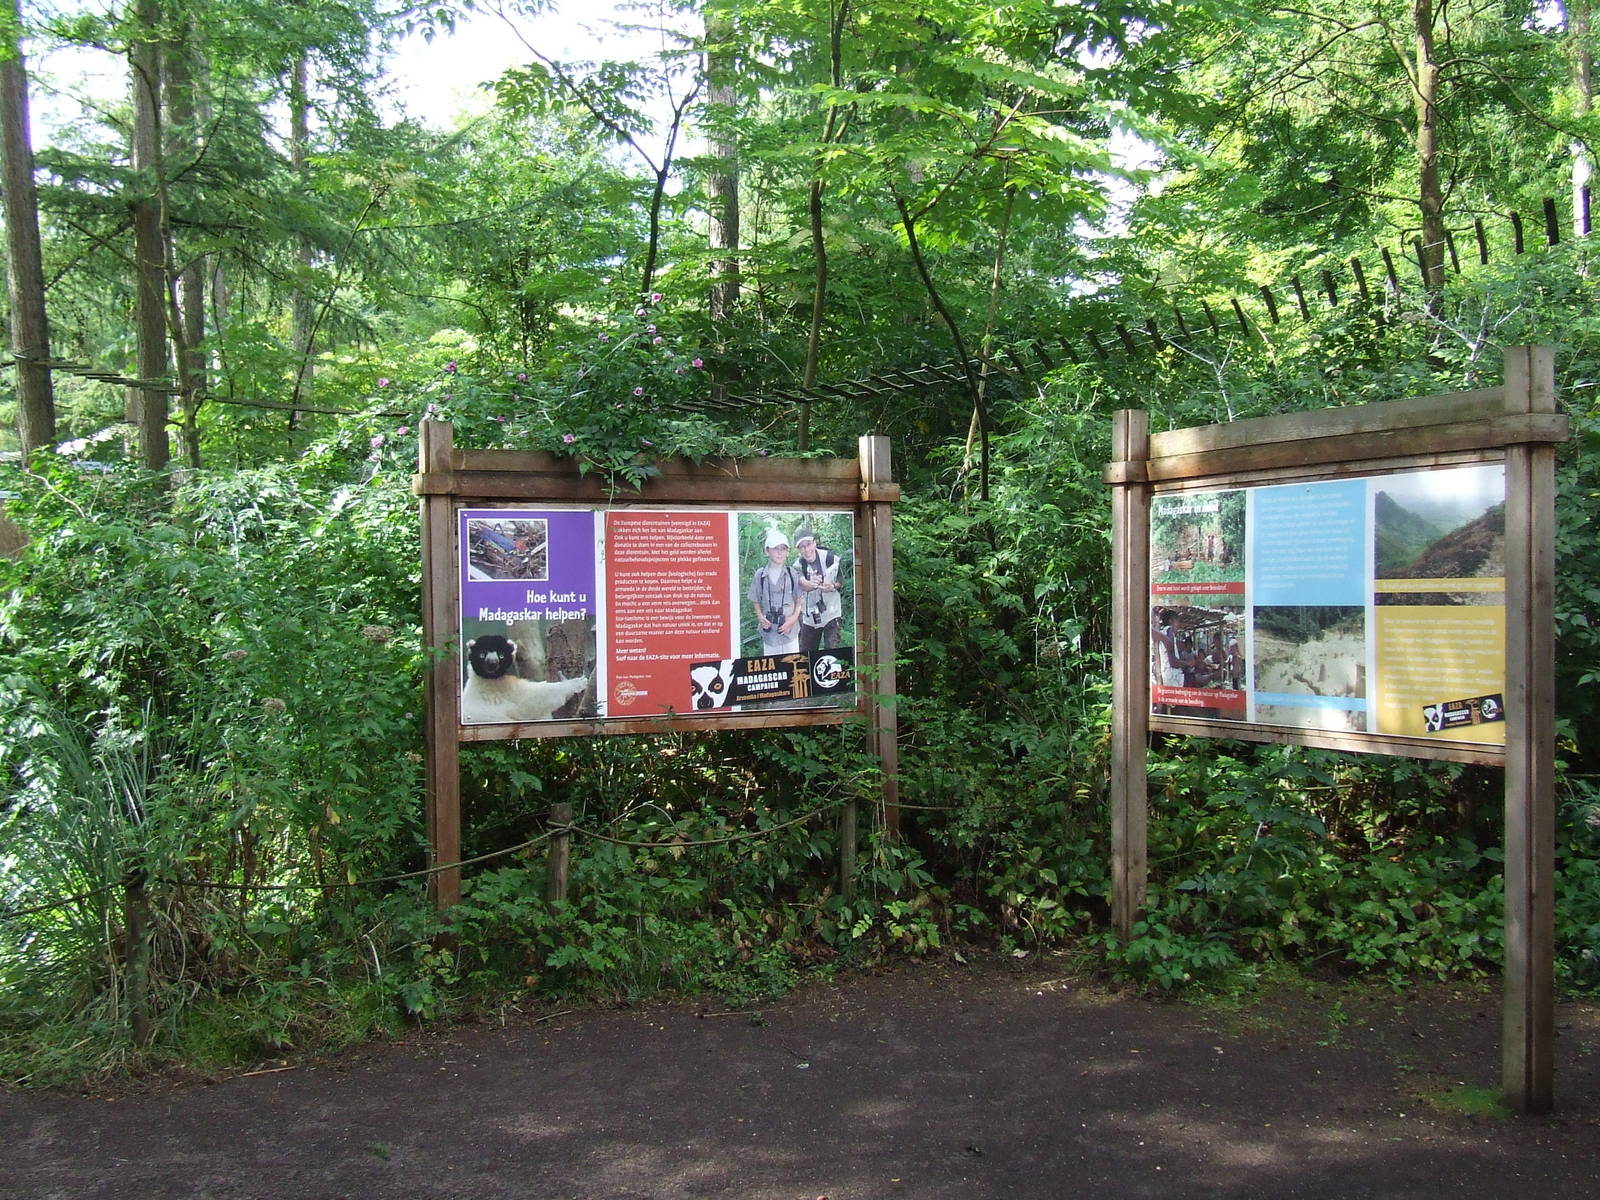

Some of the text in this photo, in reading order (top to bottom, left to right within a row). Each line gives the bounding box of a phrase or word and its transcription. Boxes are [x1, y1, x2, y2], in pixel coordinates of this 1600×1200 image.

[1159, 503, 1191, 518] Madagaskar
[527, 590, 586, 603] Hoe kunt u
[479, 607, 586, 625] Madagaskar helpen?
[747, 658, 776, 672] EAZA
[737, 672, 787, 685] MADAGASCAR
[831, 671, 851, 679] EAZA
[748, 682, 778, 691] CAMPAIGN
